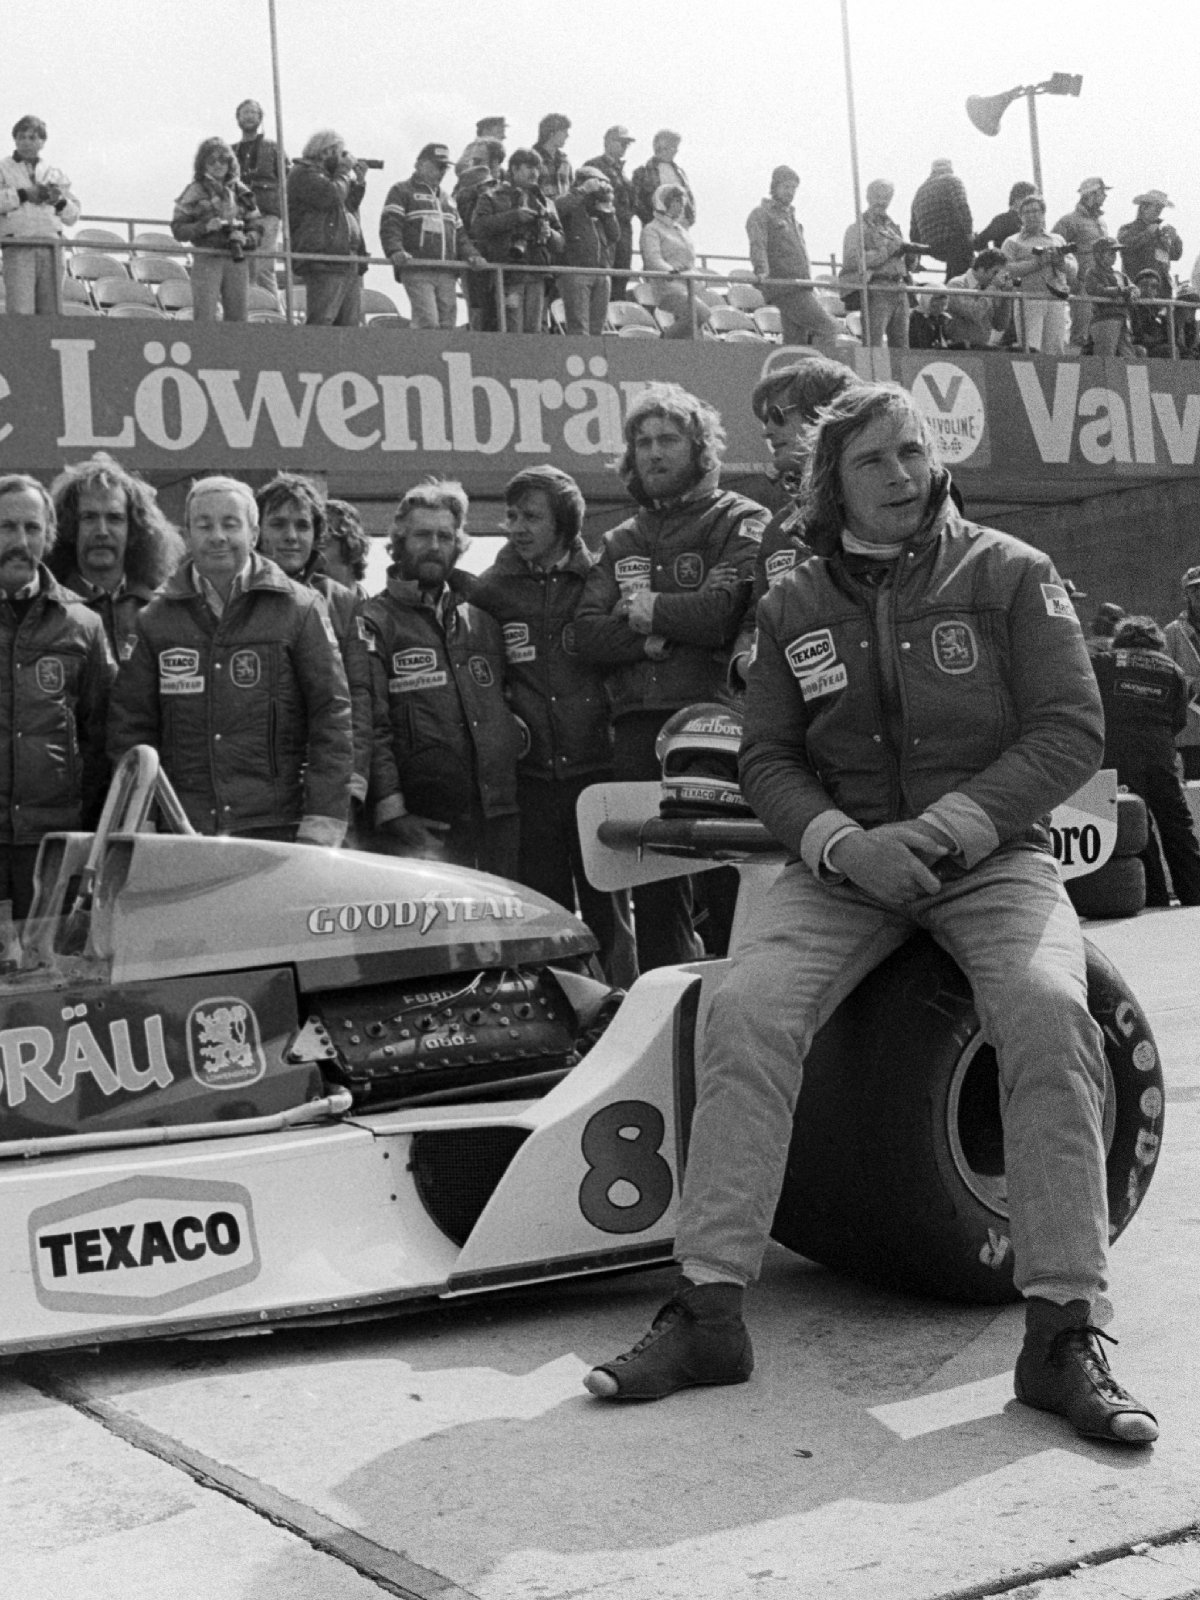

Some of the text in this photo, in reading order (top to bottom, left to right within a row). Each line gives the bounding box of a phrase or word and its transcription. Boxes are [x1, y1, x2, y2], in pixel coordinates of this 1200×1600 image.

[398, 655, 432, 667] TEXACO
[791, 641, 830, 664] TEXACO
[163, 657, 195, 667] TEXACO
[681, 788, 714, 799] TEXACO
[578, 1099, 674, 1235] 8
[39, 1211, 241, 1278] TEXACO
